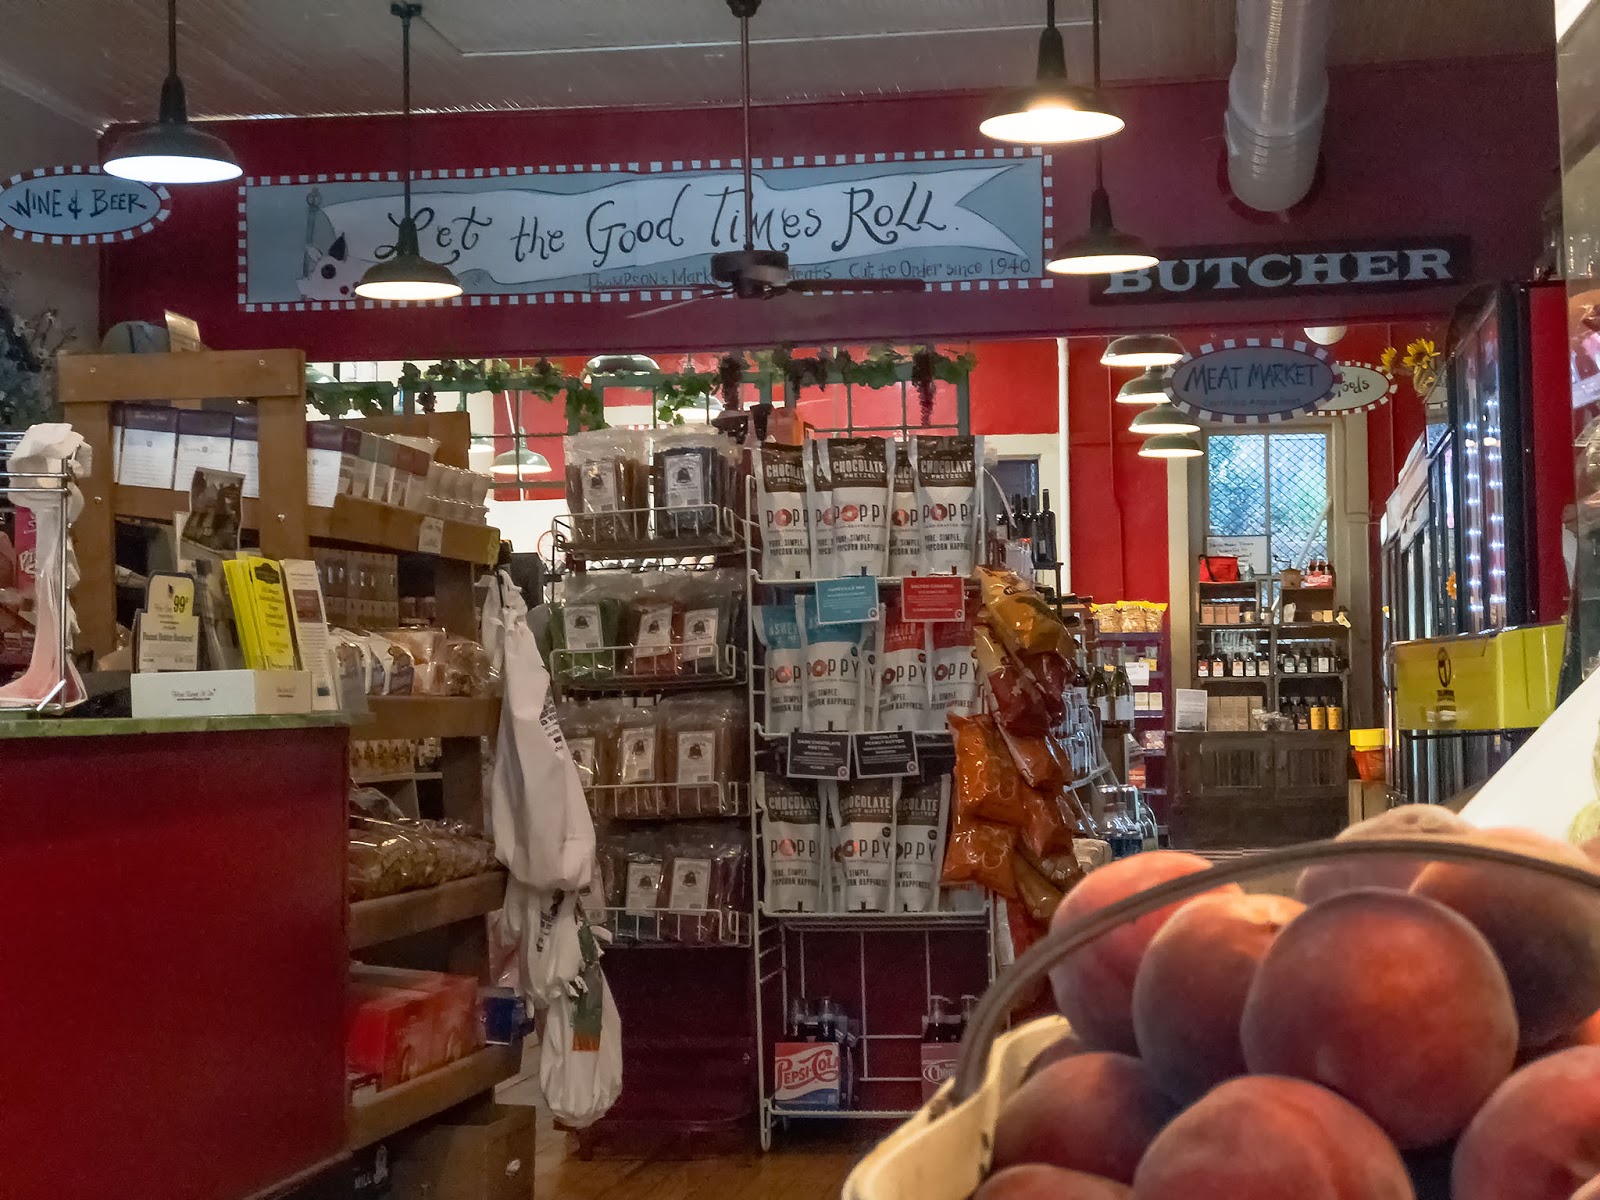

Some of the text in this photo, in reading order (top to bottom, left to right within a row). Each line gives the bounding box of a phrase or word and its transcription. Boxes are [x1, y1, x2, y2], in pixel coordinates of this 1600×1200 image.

[8, 187, 147, 220] WINE & BEER
[374, 206, 492, 265] Let
[510, 216, 565, 262] the
[586, 184, 691, 267] Good
[787, 264, 832, 280] eats
[877, 263, 896, 278] to
[900, 259, 942, 279] Order
[946, 261, 983, 276] since
[1102, 248, 1453, 294] BUTCHER
[1183, 363, 1319, 394] MEAT MARKET
[833, 459, 885, 474] CHOCOLATE
[921, 460, 972, 474] CHOCOLATE
[766, 508, 809, 528] POPP
[770, 838, 817, 858] POPP
